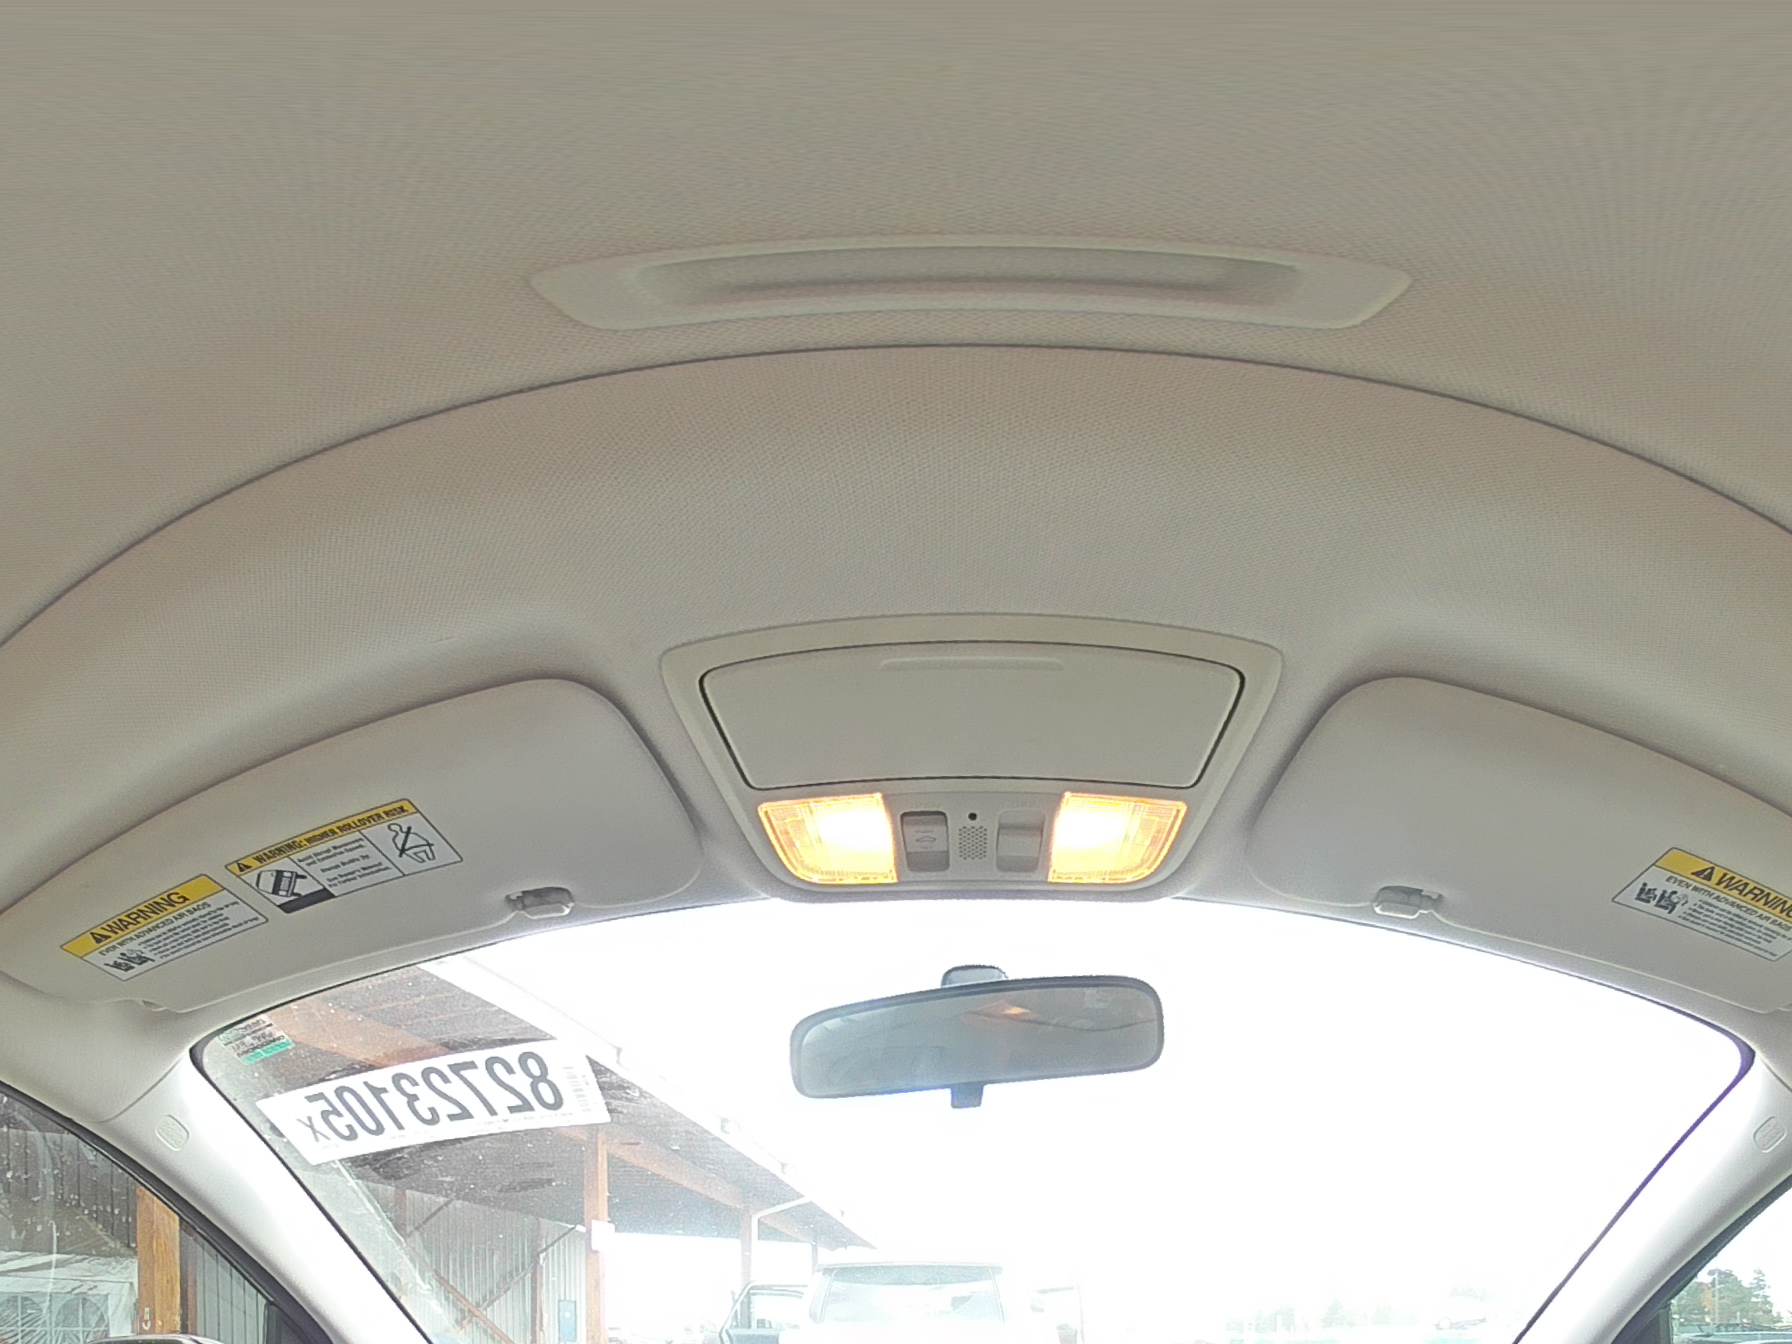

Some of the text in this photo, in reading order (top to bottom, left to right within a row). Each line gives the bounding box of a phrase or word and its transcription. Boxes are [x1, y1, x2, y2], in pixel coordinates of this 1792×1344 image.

[252, 839, 307, 865] WARNING:
[336, 813, 384, 833] ROLLOVER
[382, 805, 408, 818] RISK
[105, 891, 191, 936] WARNING
[1665, 875, 1692, 889] EVEN
[1713, 893, 1760, 916] ADVANCED
